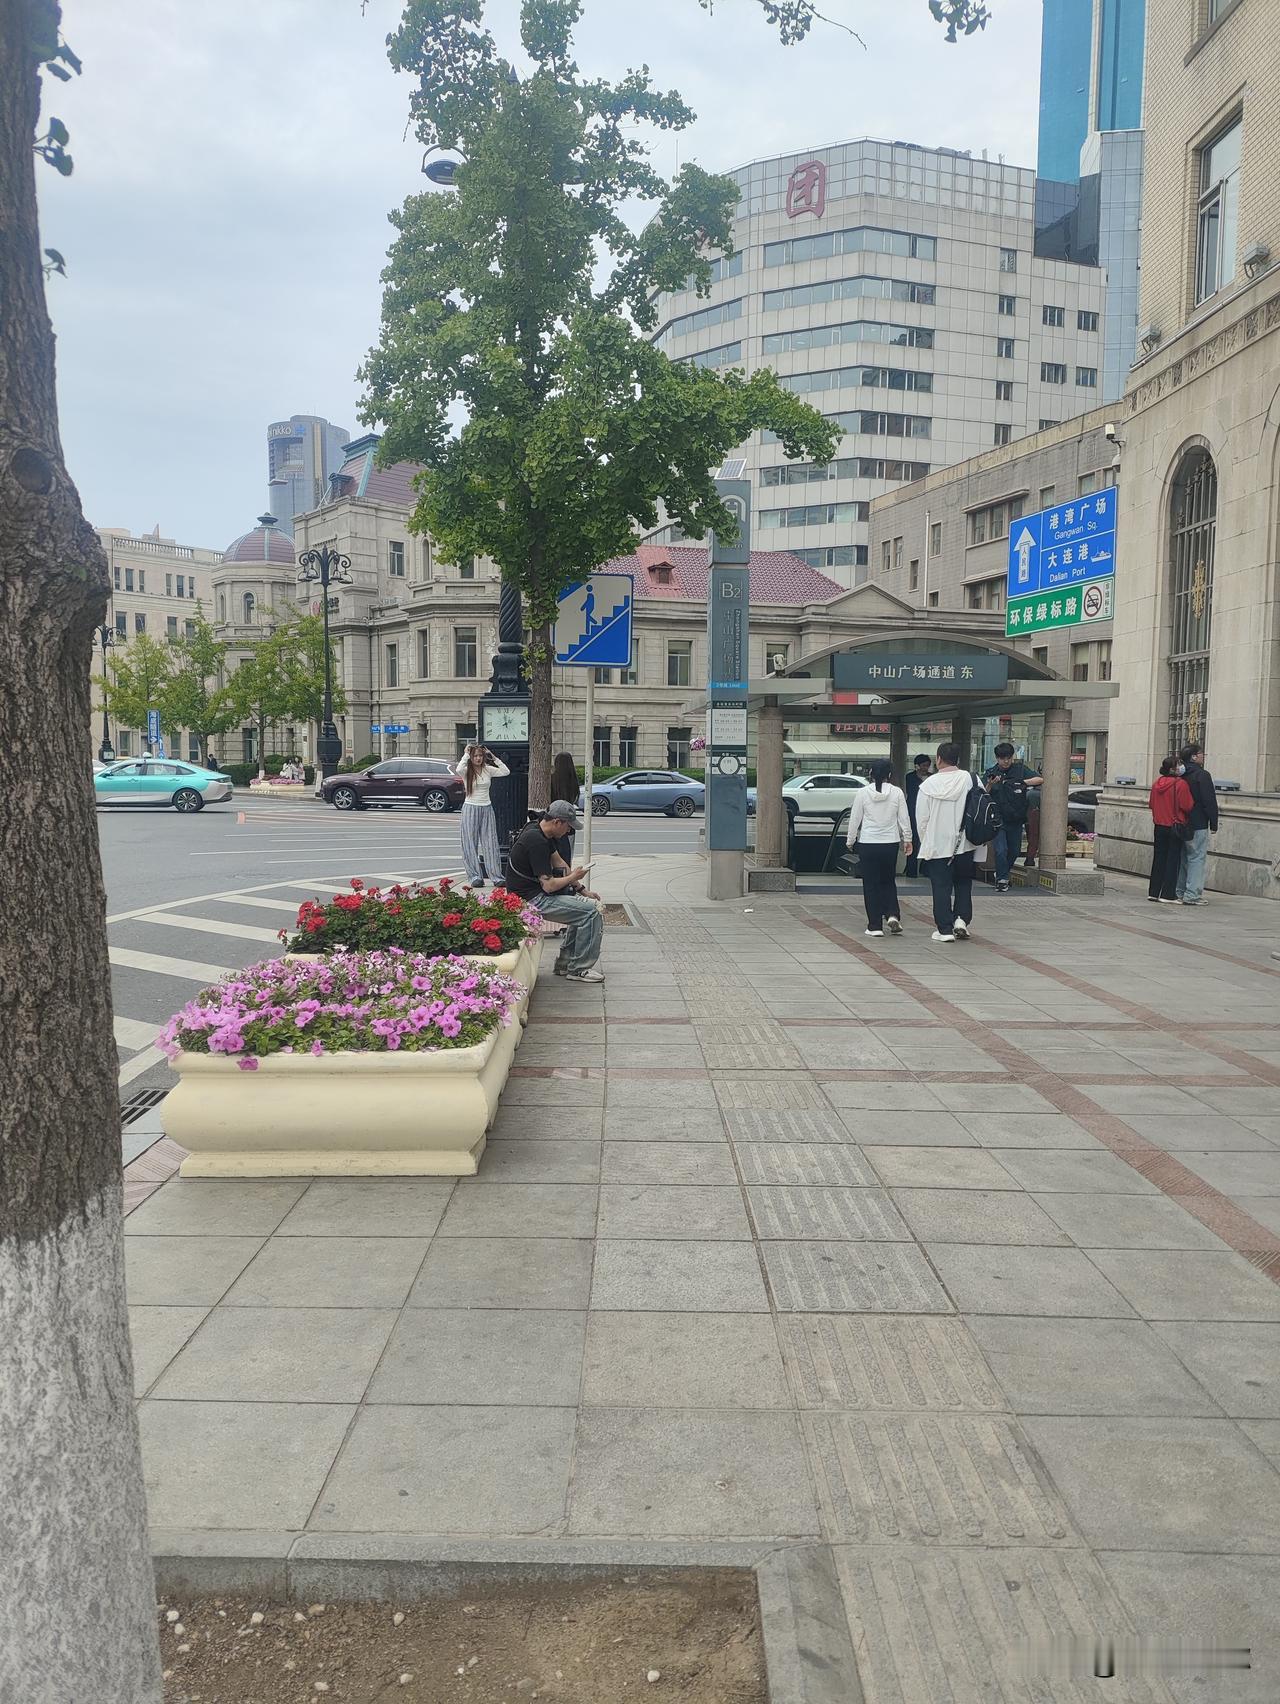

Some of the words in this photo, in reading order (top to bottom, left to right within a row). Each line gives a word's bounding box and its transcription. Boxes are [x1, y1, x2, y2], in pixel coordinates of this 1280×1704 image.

[272, 424, 292, 437] nikko
[1049, 497, 1107, 530] 港湾广场
[1054, 525, 1084, 540] Gangwan
[1048, 543, 1089, 569] 大连港
[1049, 571, 1068, 583] Dalian
[1072, 566, 1086, 577] Port
[722, 582, 741, 598] B2
[1009, 596, 1077, 627] 环保绿标路
